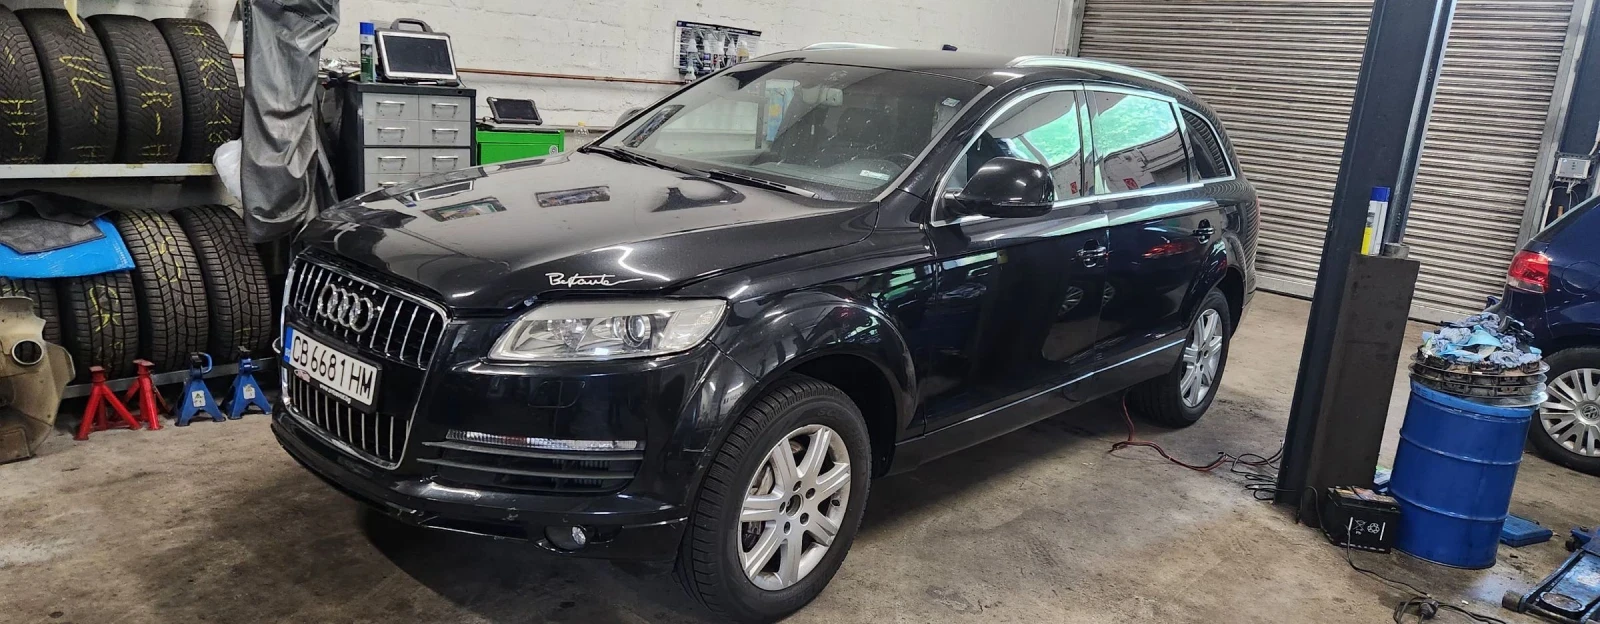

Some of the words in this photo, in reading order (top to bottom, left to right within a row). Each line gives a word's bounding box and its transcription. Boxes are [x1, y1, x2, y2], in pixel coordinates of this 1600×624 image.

[292, 335, 309, 367] CB
[310, 345, 346, 387] 6681
[348, 362, 373, 399] HM
